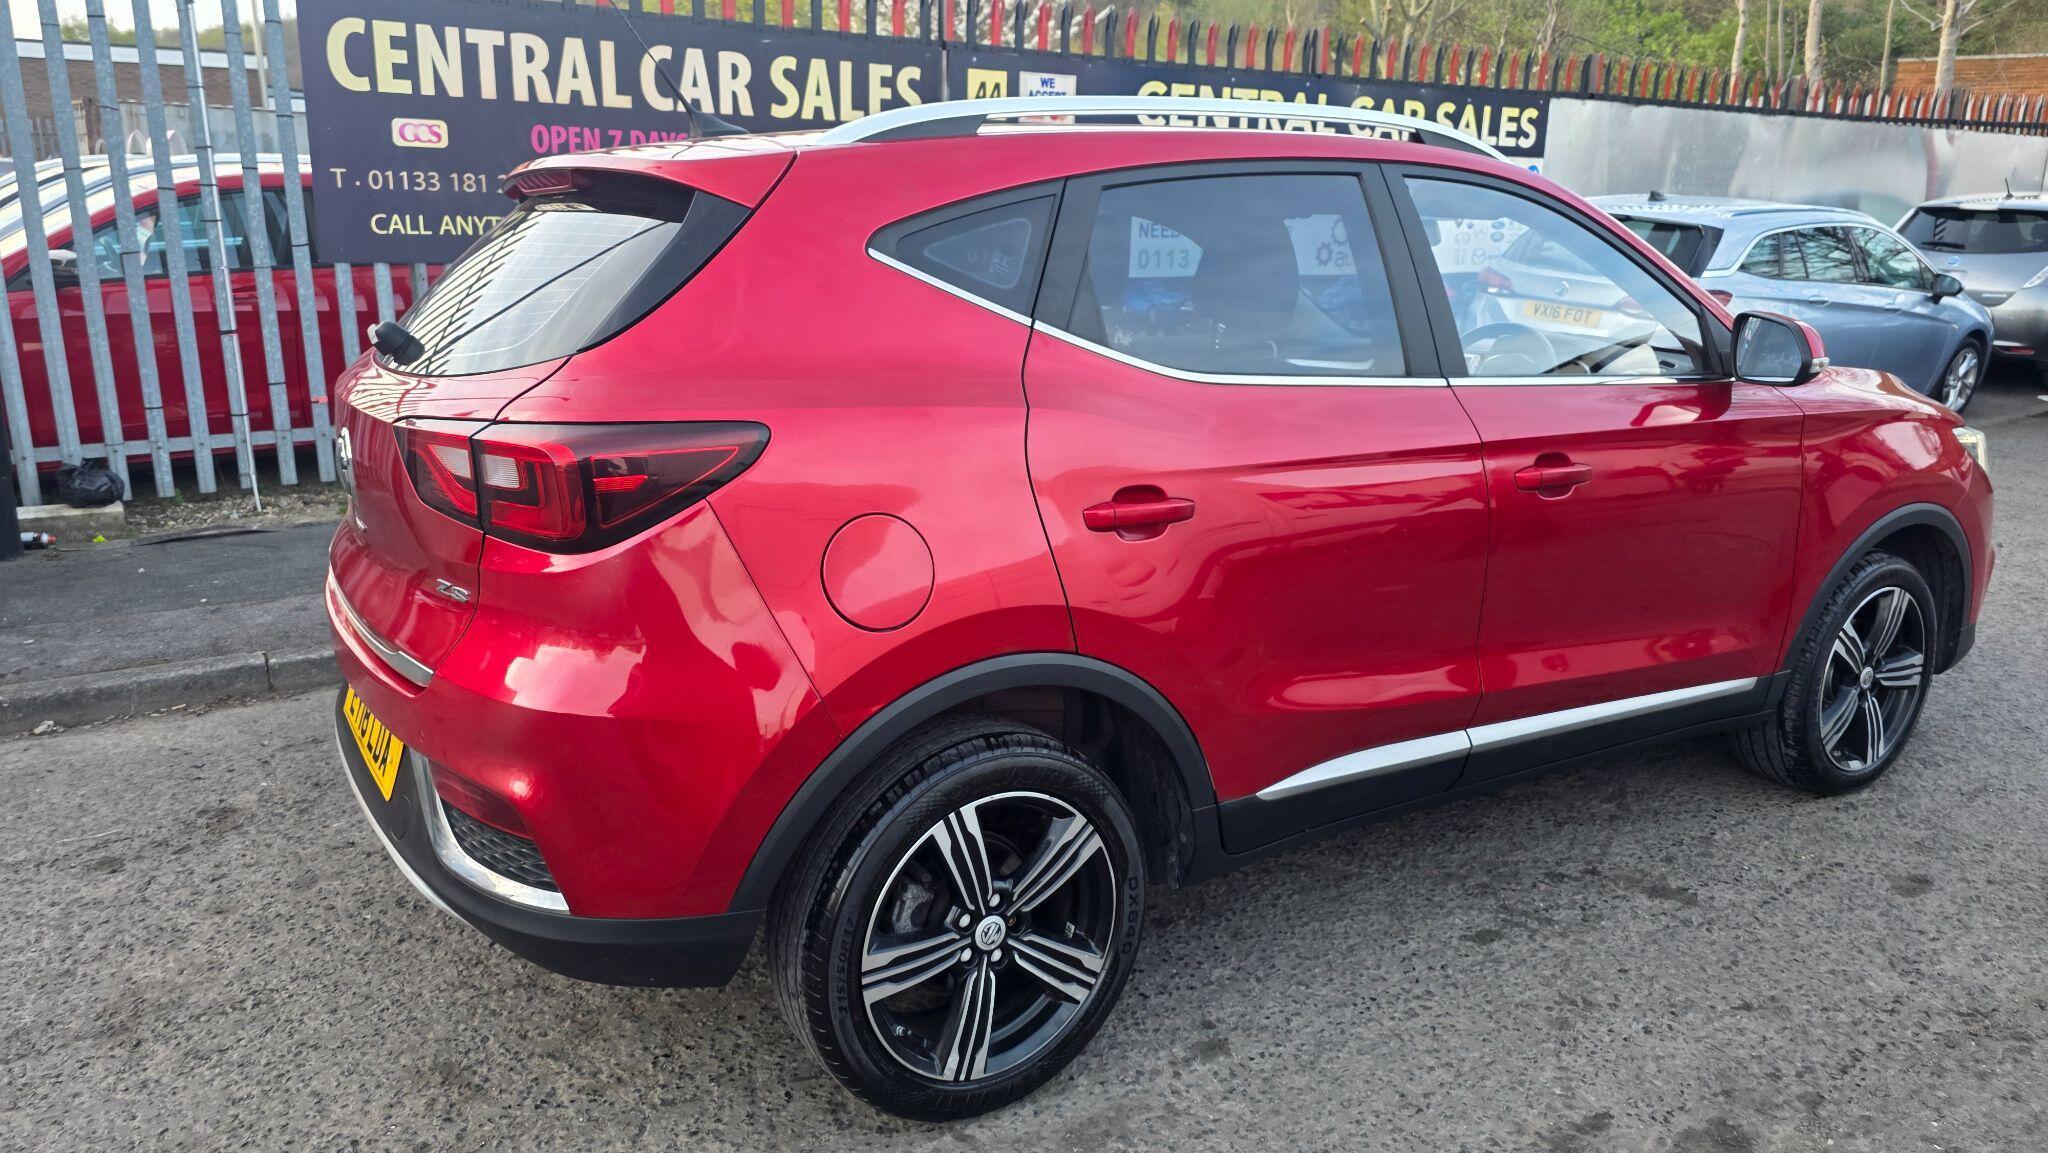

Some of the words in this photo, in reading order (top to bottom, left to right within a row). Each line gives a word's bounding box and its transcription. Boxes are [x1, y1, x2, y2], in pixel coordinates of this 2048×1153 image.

[326, 17, 633, 109] CENTRAL
[640, 45, 755, 117] CAR
[770, 55, 923, 121] SALES
[1040, 77, 1056, 89] WE
[399, 122, 442, 144] CCS
[1436, 101, 1539, 149] SALES
[531, 124, 600, 154] OPEN
[368, 170, 441, 191] 01133
[450, 173, 488, 193] 181
[370, 213, 432, 235] CALL
[1138, 249, 1190, 269] 0113
[1534, 302, 1562, 319] VX16
[1564, 307, 1593, 325] FOT
[436, 578, 471, 602] ZS
